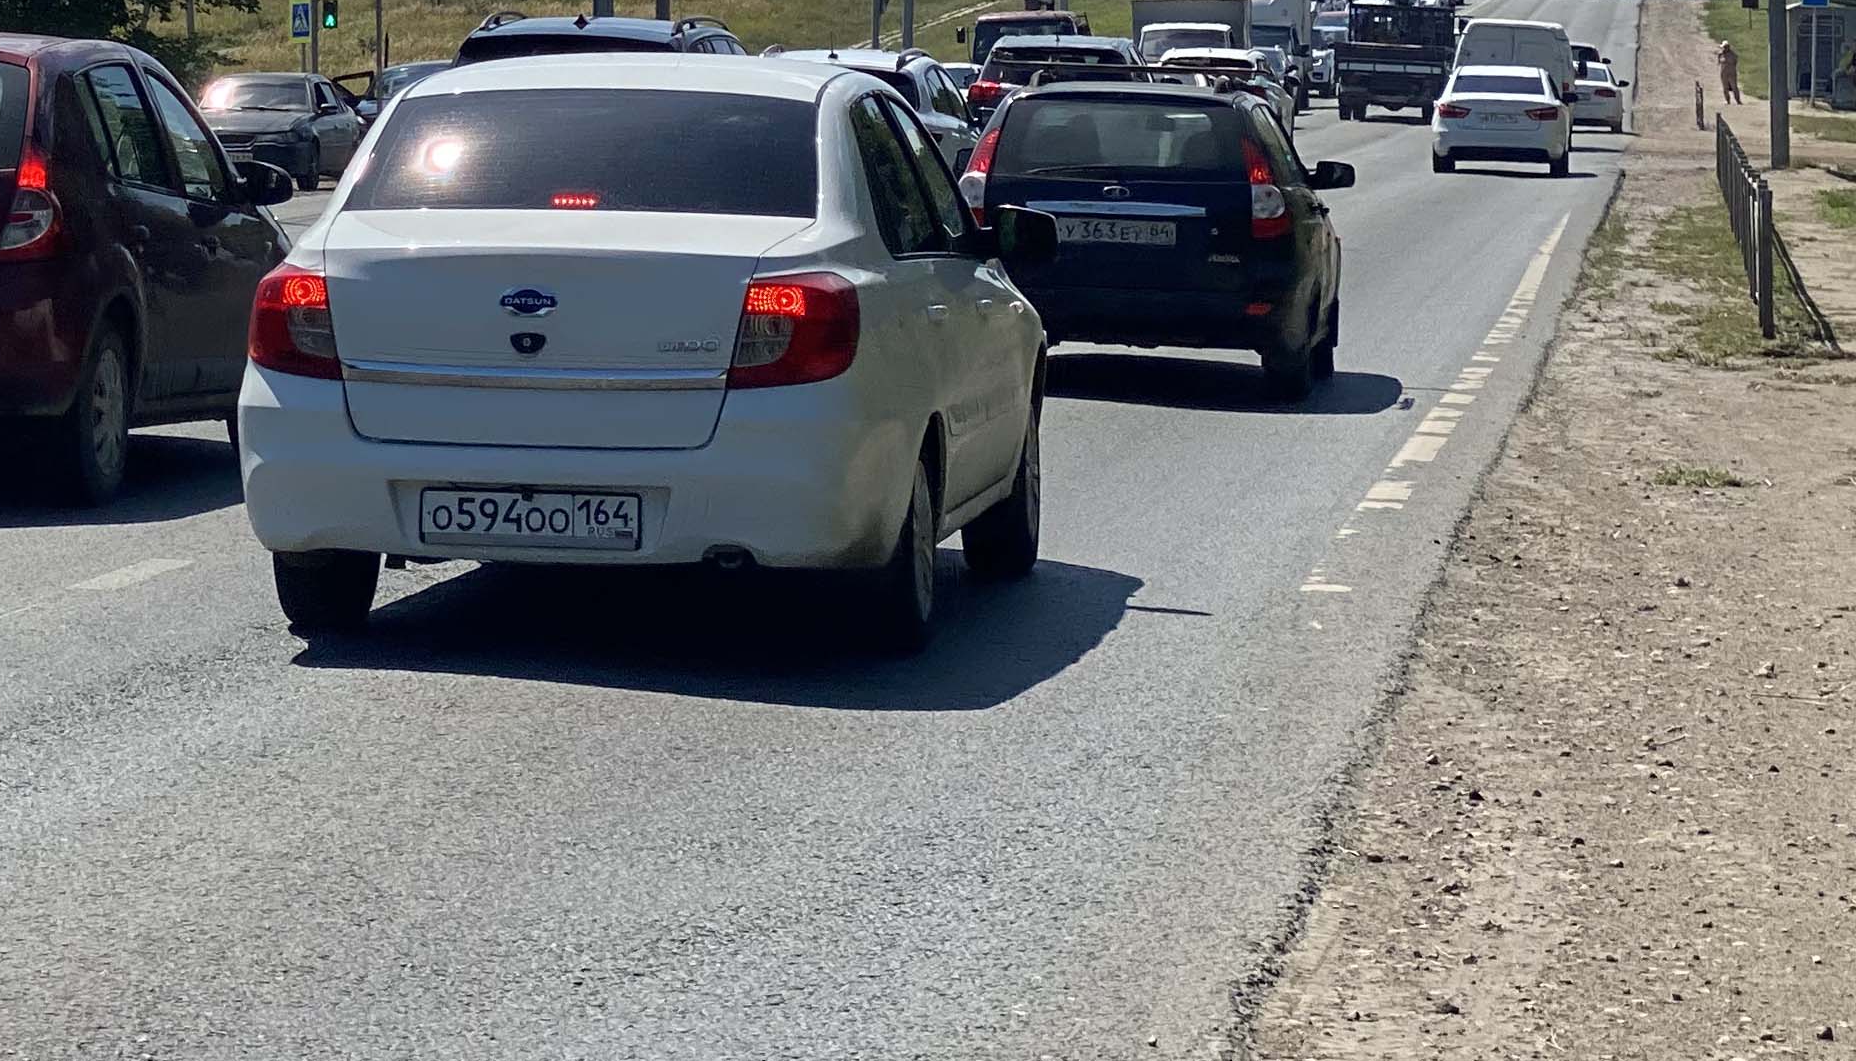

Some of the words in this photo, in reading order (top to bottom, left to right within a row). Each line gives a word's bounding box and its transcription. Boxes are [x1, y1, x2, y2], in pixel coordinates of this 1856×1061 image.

[504, 297, 552, 305] DATSUN
[431, 497, 571, 534] О594ОО
[576, 499, 630, 527] 164
[586, 526, 615, 539] RUS
